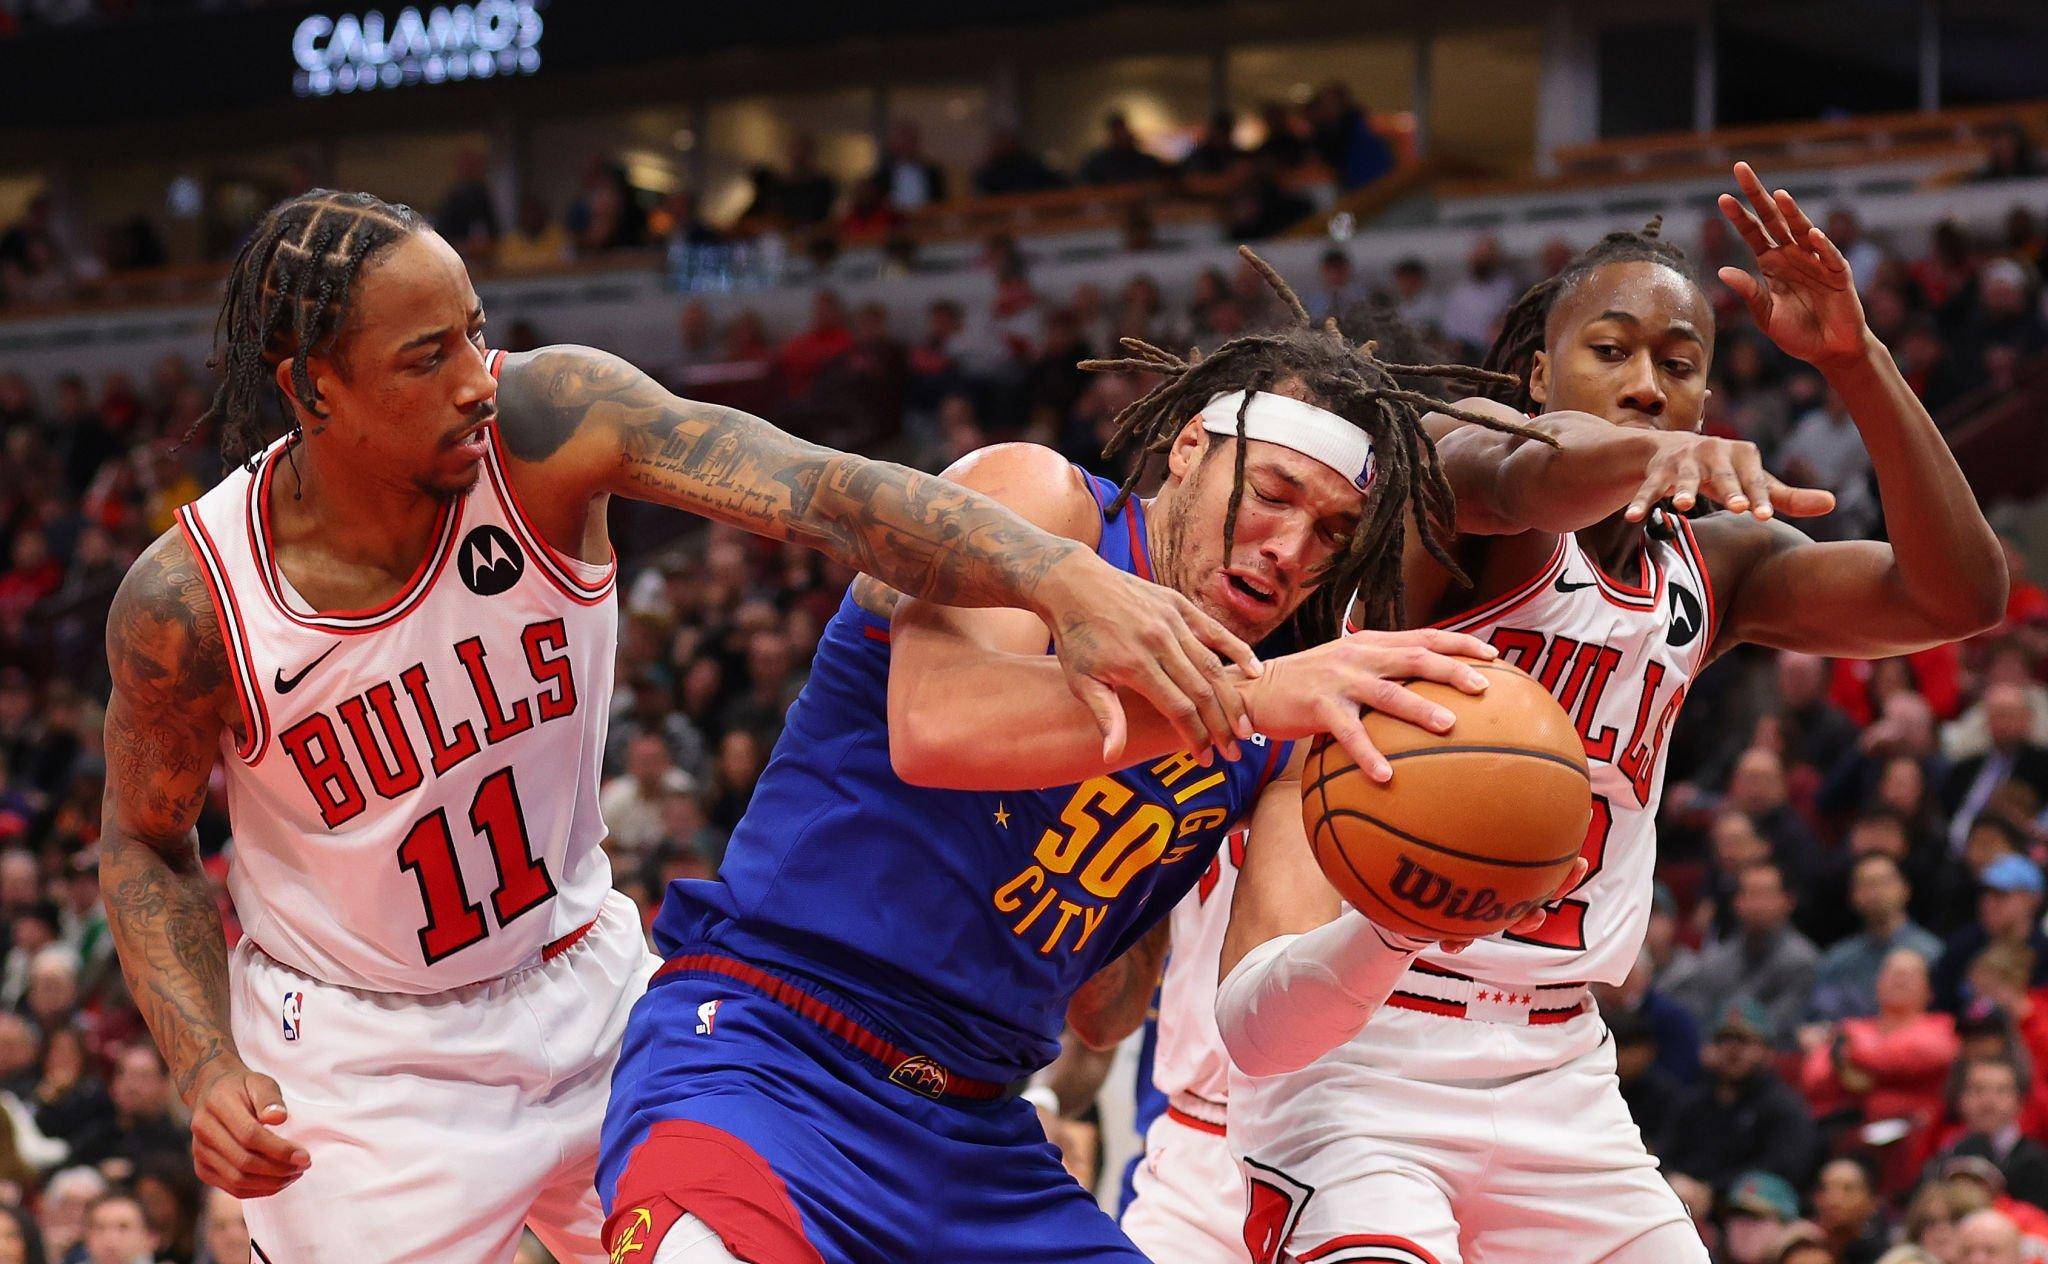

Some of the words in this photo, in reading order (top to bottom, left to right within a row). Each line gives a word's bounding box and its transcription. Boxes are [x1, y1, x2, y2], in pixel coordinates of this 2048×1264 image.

[292, 0, 543, 72] CALAMOS
[279, 617, 577, 829] BULLS
[396, 765, 557, 966] 11
[1033, 774, 1176, 899] 50
[1389, 852, 1545, 923] Wilso
[993, 864, 1109, 954] CITY
